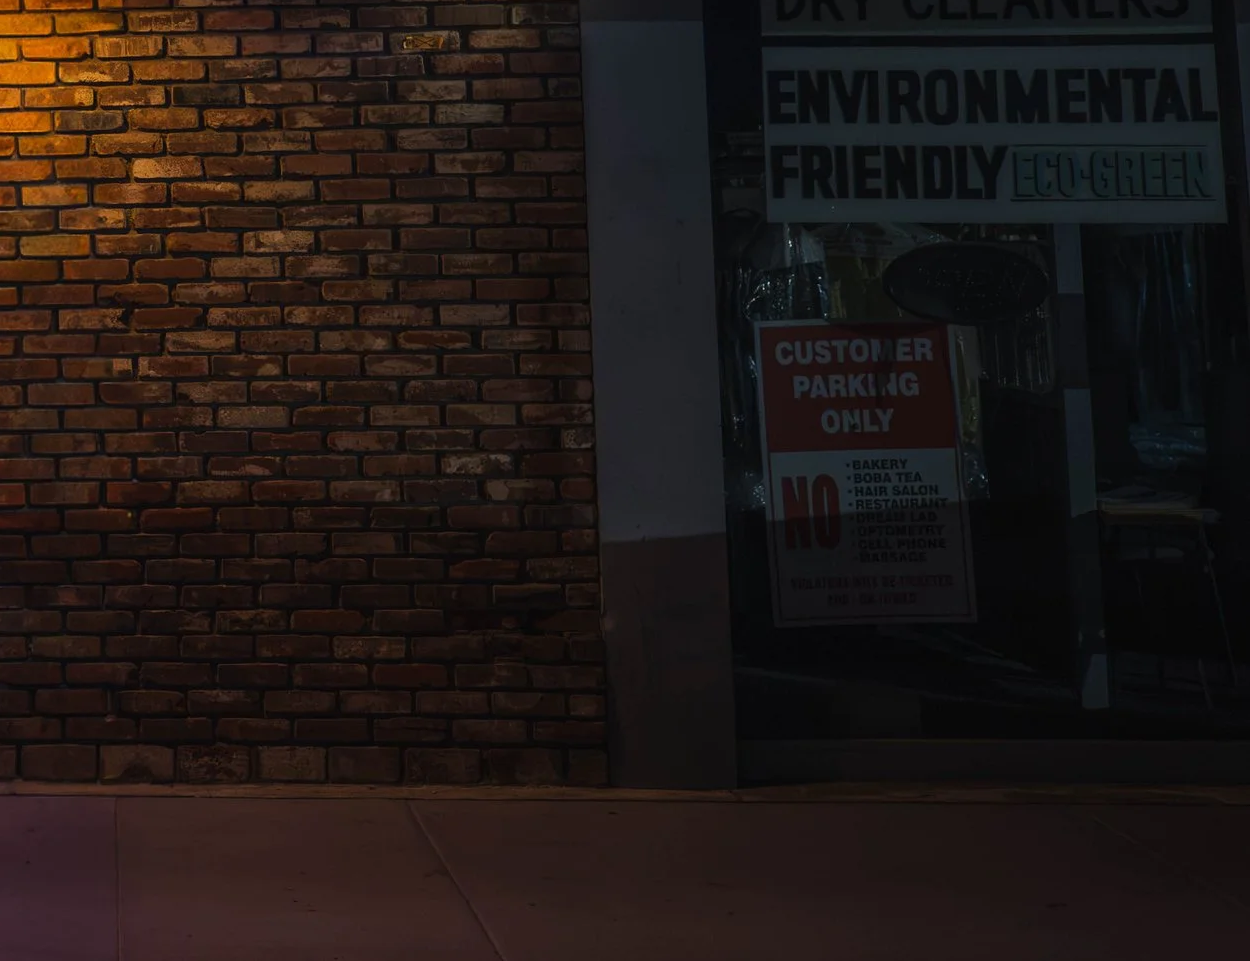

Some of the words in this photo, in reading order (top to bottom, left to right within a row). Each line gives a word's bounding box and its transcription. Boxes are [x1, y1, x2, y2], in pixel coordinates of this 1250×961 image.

[766, 68, 1218, 125] ENVIRONMENTAL
[769, 145, 1008, 199] FRIENDLY
[1013, 149, 1212, 198] ECO-GREEN
[775, 337, 934, 366] CUSTOMER
[793, 372, 920, 399] PARKING
[821, 408, 894, 434] ONLY
[852, 459, 908, 470] BAKERY
[854, 472, 892, 484] BOBA
[895, 471, 923, 482] TEA
[855, 486, 888, 497] HAIR
[892, 485, 939, 496] SALON
[856, 498, 948, 510] RESTAURANT
[781, 473, 842, 551] NO
[858, 539, 892, 550] CELL
